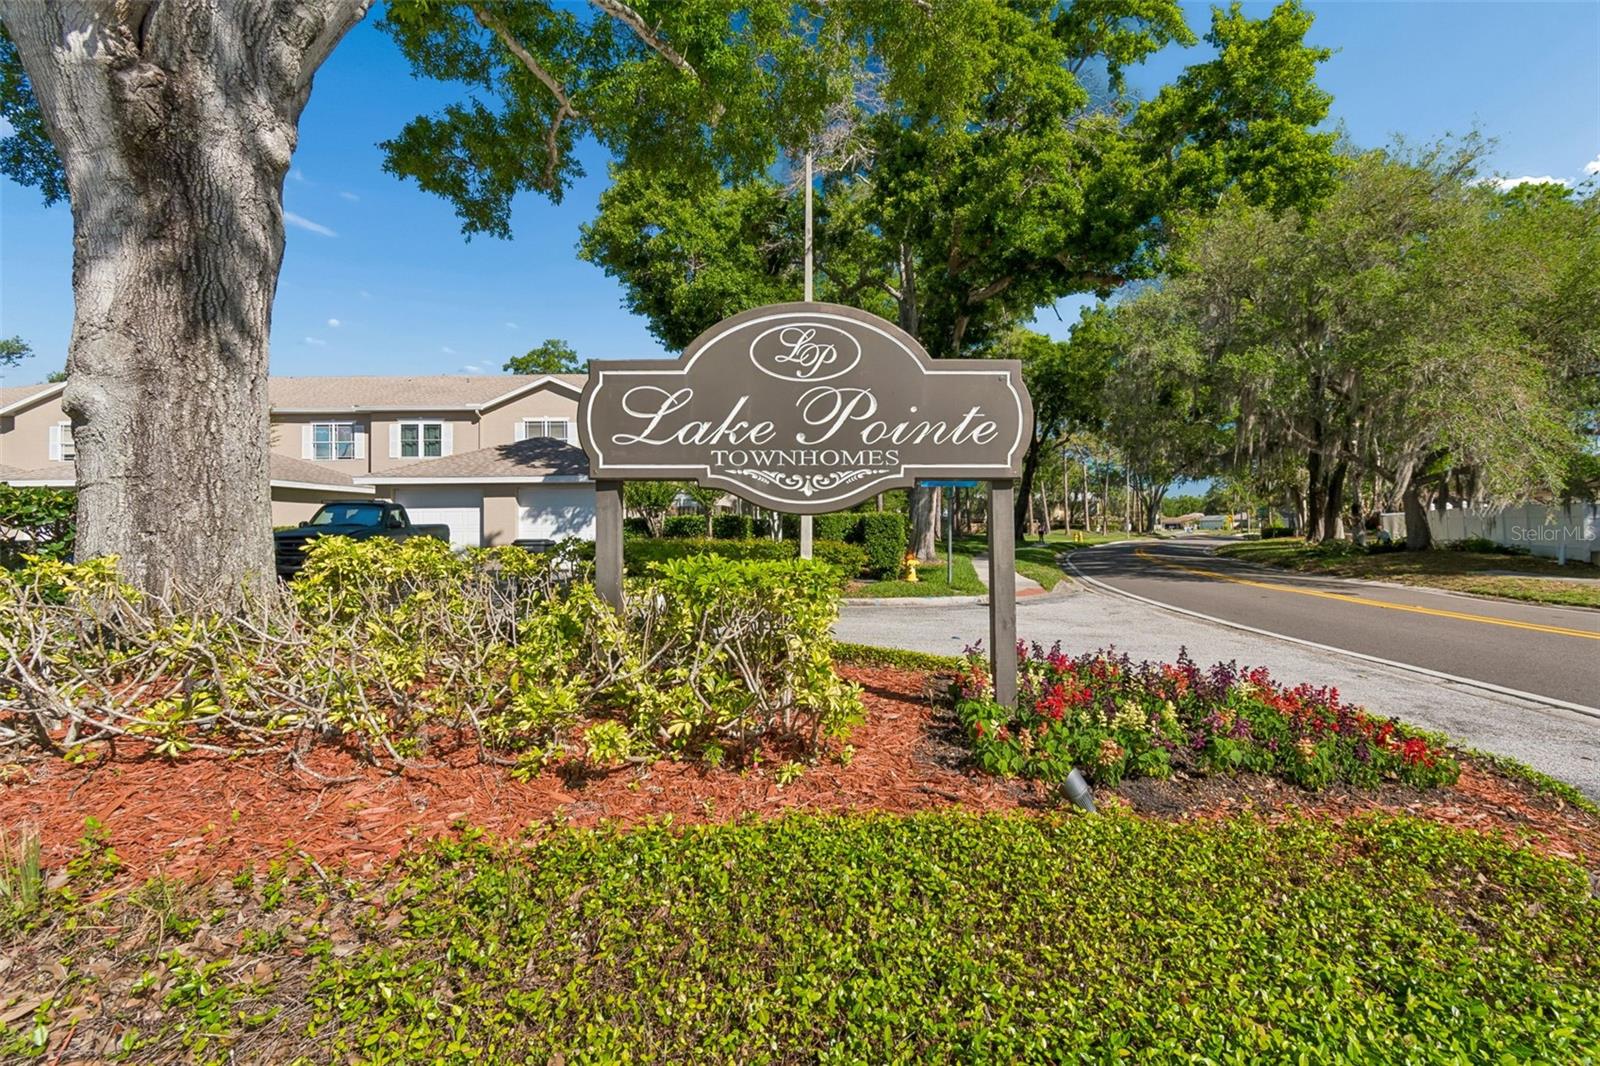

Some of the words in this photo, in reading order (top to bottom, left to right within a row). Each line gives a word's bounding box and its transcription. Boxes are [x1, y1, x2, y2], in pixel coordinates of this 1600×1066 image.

[774, 327, 837, 377] LP
[612, 386, 776, 446] Lake
[795, 386, 998, 445] Pointe
[711, 449, 899, 467] TOWNHOMES
